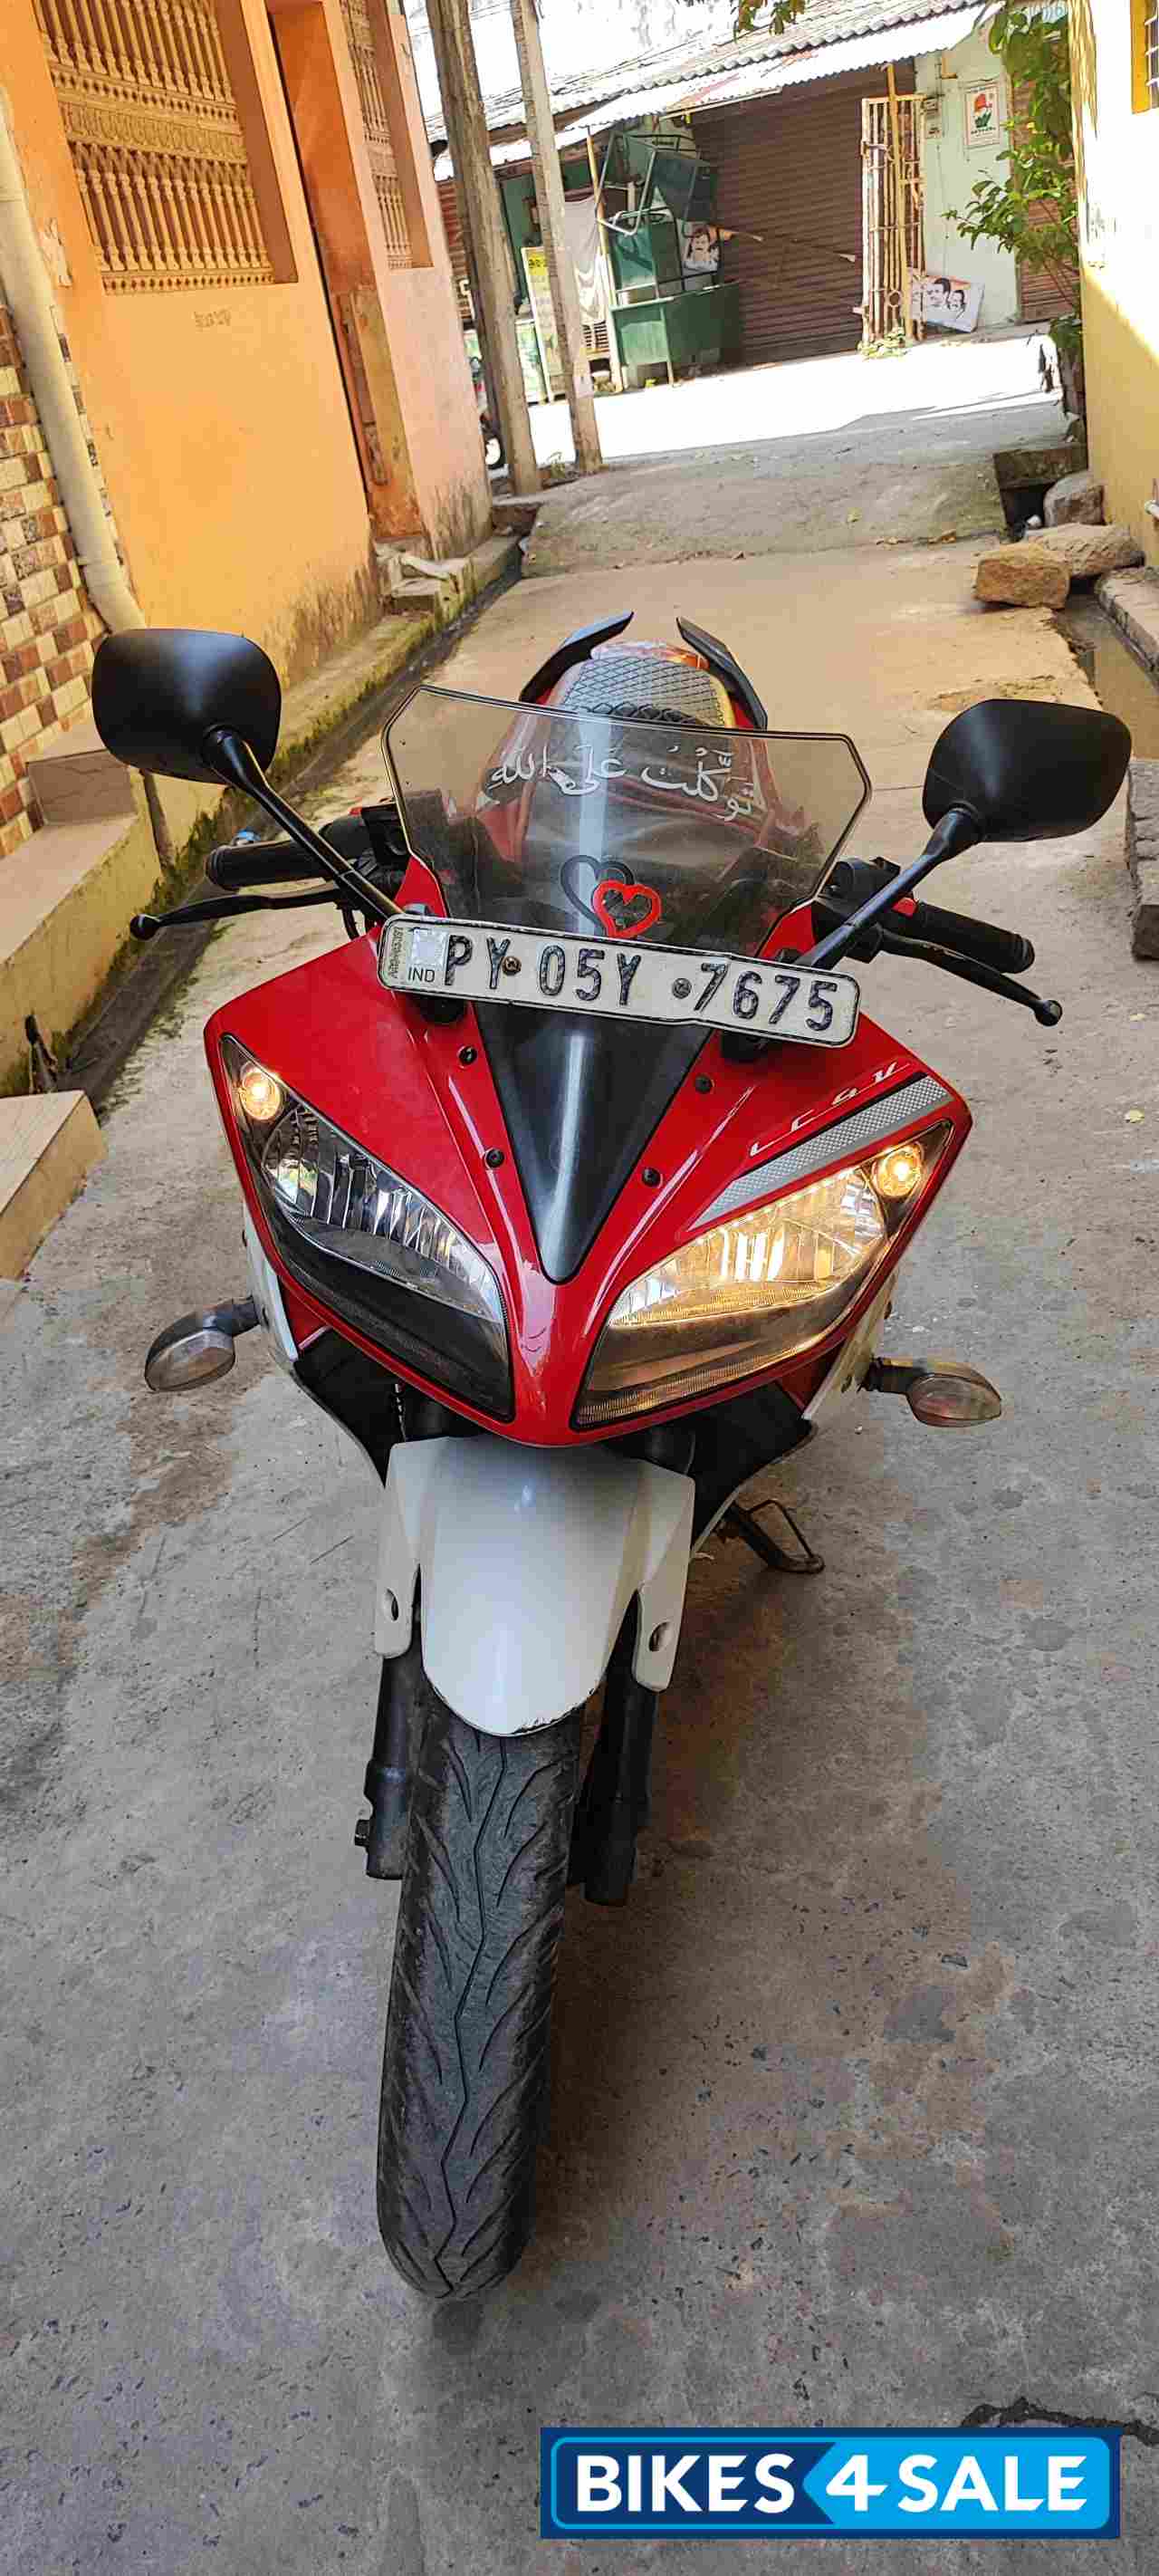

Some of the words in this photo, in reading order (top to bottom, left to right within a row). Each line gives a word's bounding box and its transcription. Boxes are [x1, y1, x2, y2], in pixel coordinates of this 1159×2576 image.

[407, 966, 436, 983] IND
[444, 935, 512, 990] PY
[539, 944, 642, 1006] 05Y
[693, 961, 838, 1032] 7675
